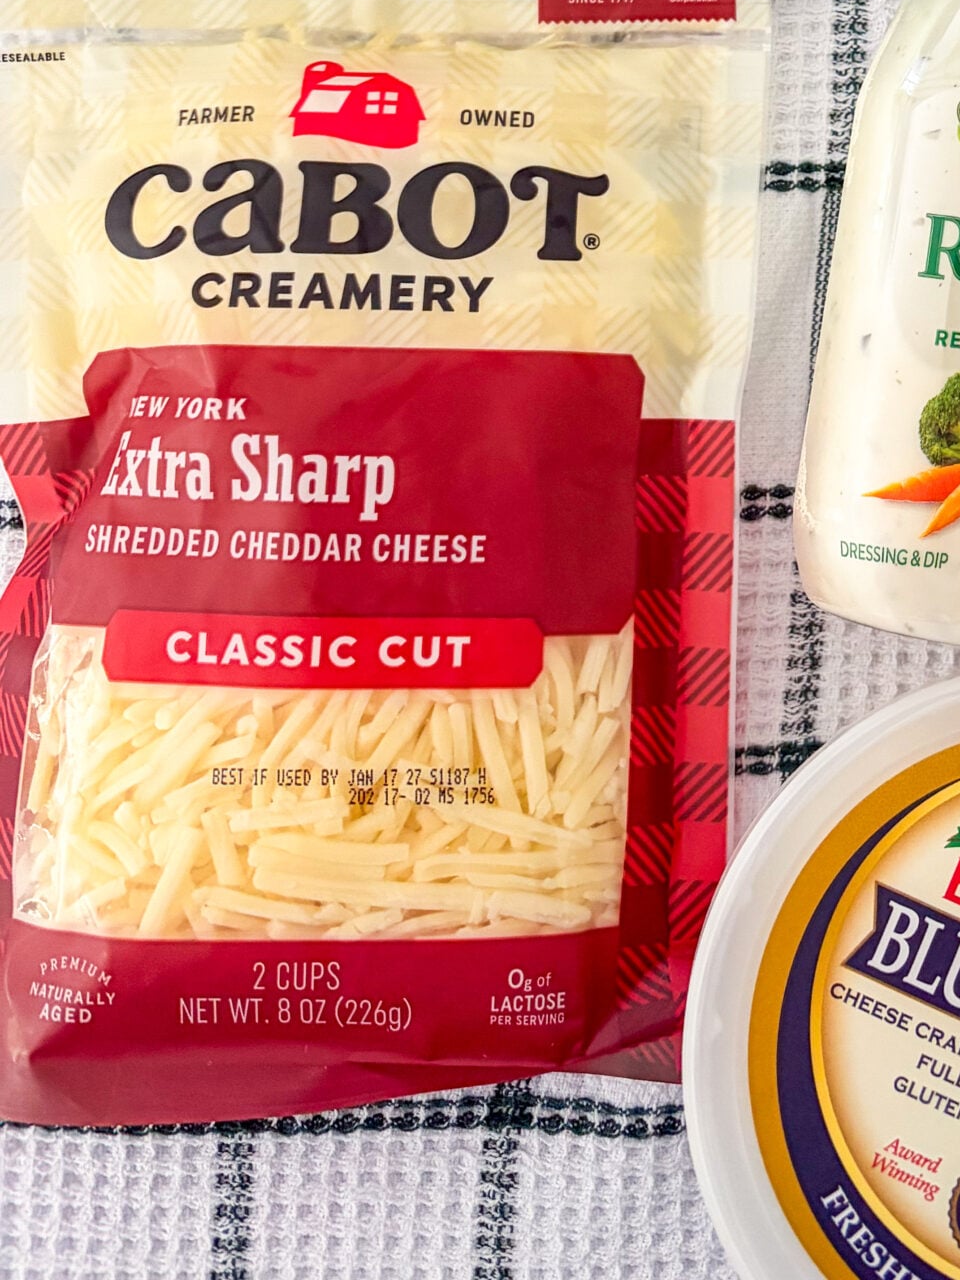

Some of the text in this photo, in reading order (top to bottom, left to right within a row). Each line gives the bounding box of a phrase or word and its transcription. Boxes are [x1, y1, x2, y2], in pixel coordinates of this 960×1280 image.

[0, 51, 66, 63] ESEALABLE
[178, 105, 255, 127] FARMER
[459, 108, 535, 129] OWNED
[191, 271, 494, 313] CREAMERY
[174, 396, 247, 420] YORK
[100, 430, 397, 521] Extra Sharp
[84, 523, 487, 564] SHREDDED CHEDDAR CHEESE
[839, 540, 949, 569] DRESSING & DIP
[165, 631, 472, 668] CLASSIC CUT
[212, 767, 244, 786] BEST
[252, 768, 267, 786] IF
[277, 768, 312, 786] USED
[320, 769, 339, 786] BY
[348, 768, 374, 786] JAN
[382, 768, 398, 786] 17
[406, 768, 422, 786] 27
[478, 767, 487, 786] H
[40, 955, 112, 987] PREMIUM
[253, 961, 341, 991] 2 CUPS
[29, 981, 116, 1006] NATURALLY
[490, 992, 566, 1013] LACTOSE
[830, 982, 913, 1033] CHEESE
[39, 1003, 92, 1024] AGED
[180, 997, 412, 1032] NET WT. 8 OZ (226g)
[490, 1012, 566, 1026] PER SERVING
[884, 1138, 943, 1174] Award
[871, 1152, 941, 1202] Winning
